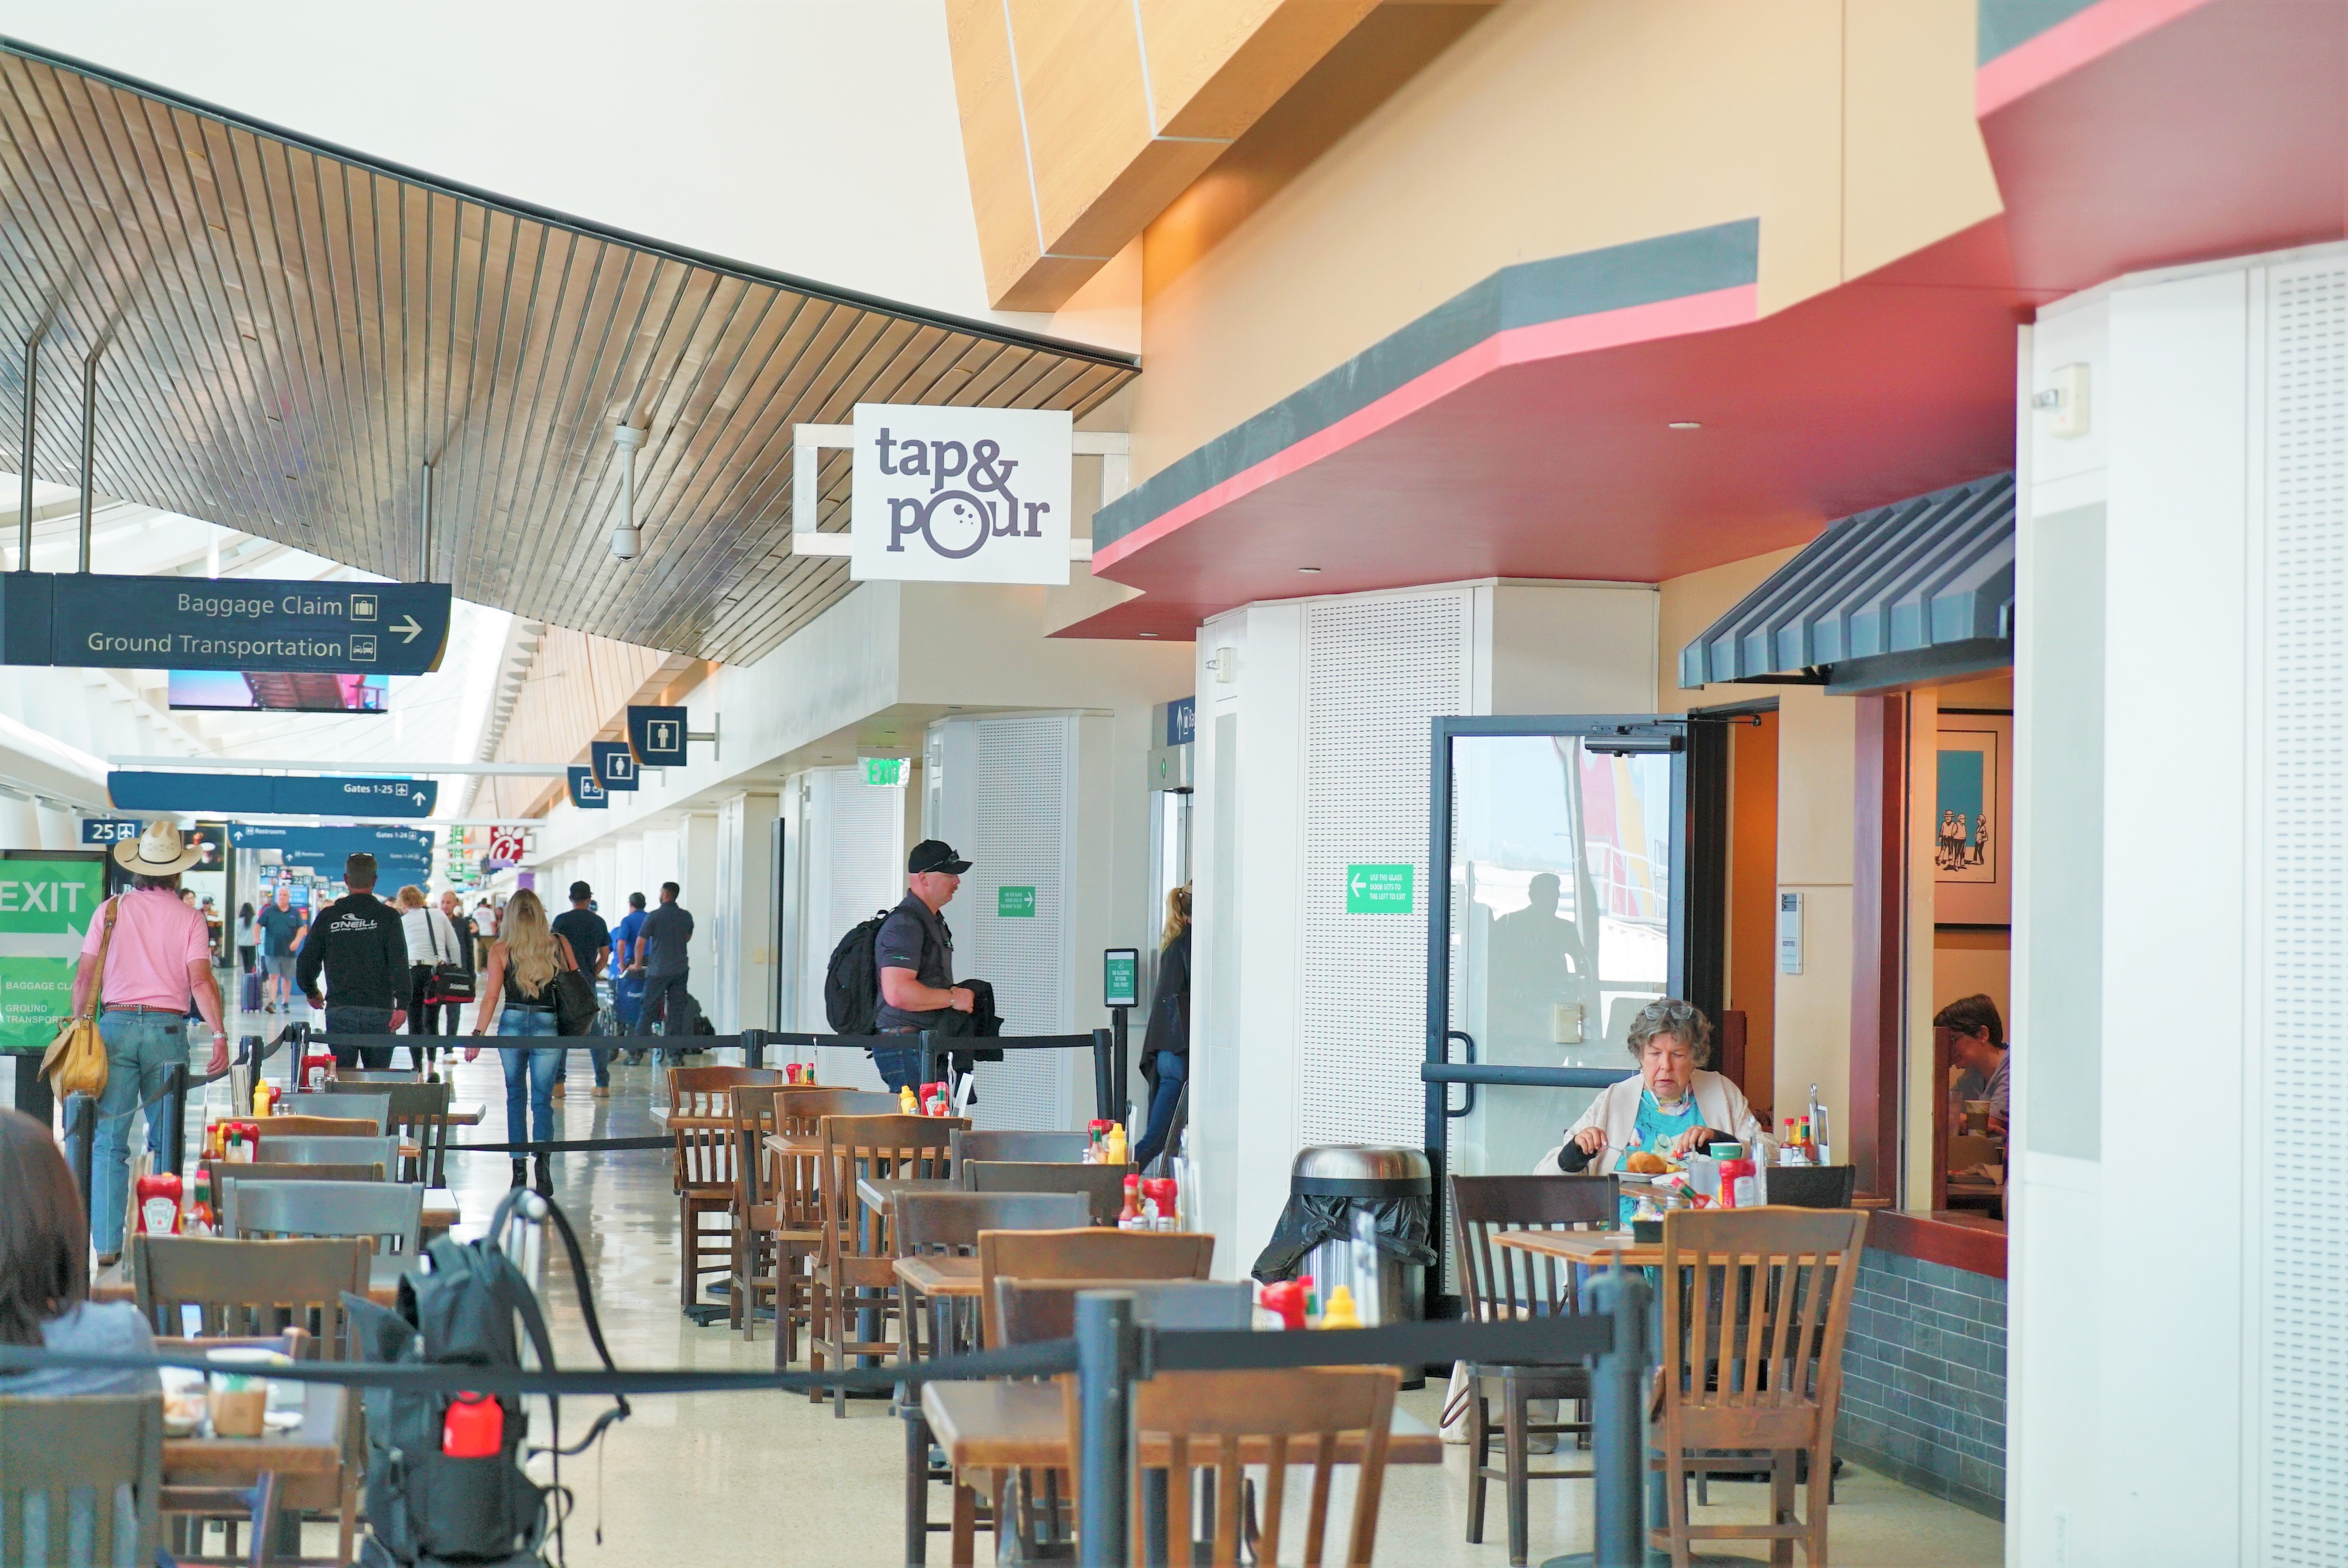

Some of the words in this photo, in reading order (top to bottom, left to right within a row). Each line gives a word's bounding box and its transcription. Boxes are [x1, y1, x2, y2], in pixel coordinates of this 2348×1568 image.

[876, 428, 1018, 494] tap&
[887, 490, 1051, 559] pour
[178, 594, 275, 617] Baggage
[282, 596, 342, 615] Claim
[88, 633, 172, 652] Ground
[179, 635, 342, 659] Transportation
[868, 759, 902, 785] EXIT
[344, 783, 371, 793] Gates
[373, 785, 393, 794] 1-25
[92, 824, 114, 839] 25
[0, 881, 85, 912] EXIT
[6, 982, 55, 990] BAGGAGE
